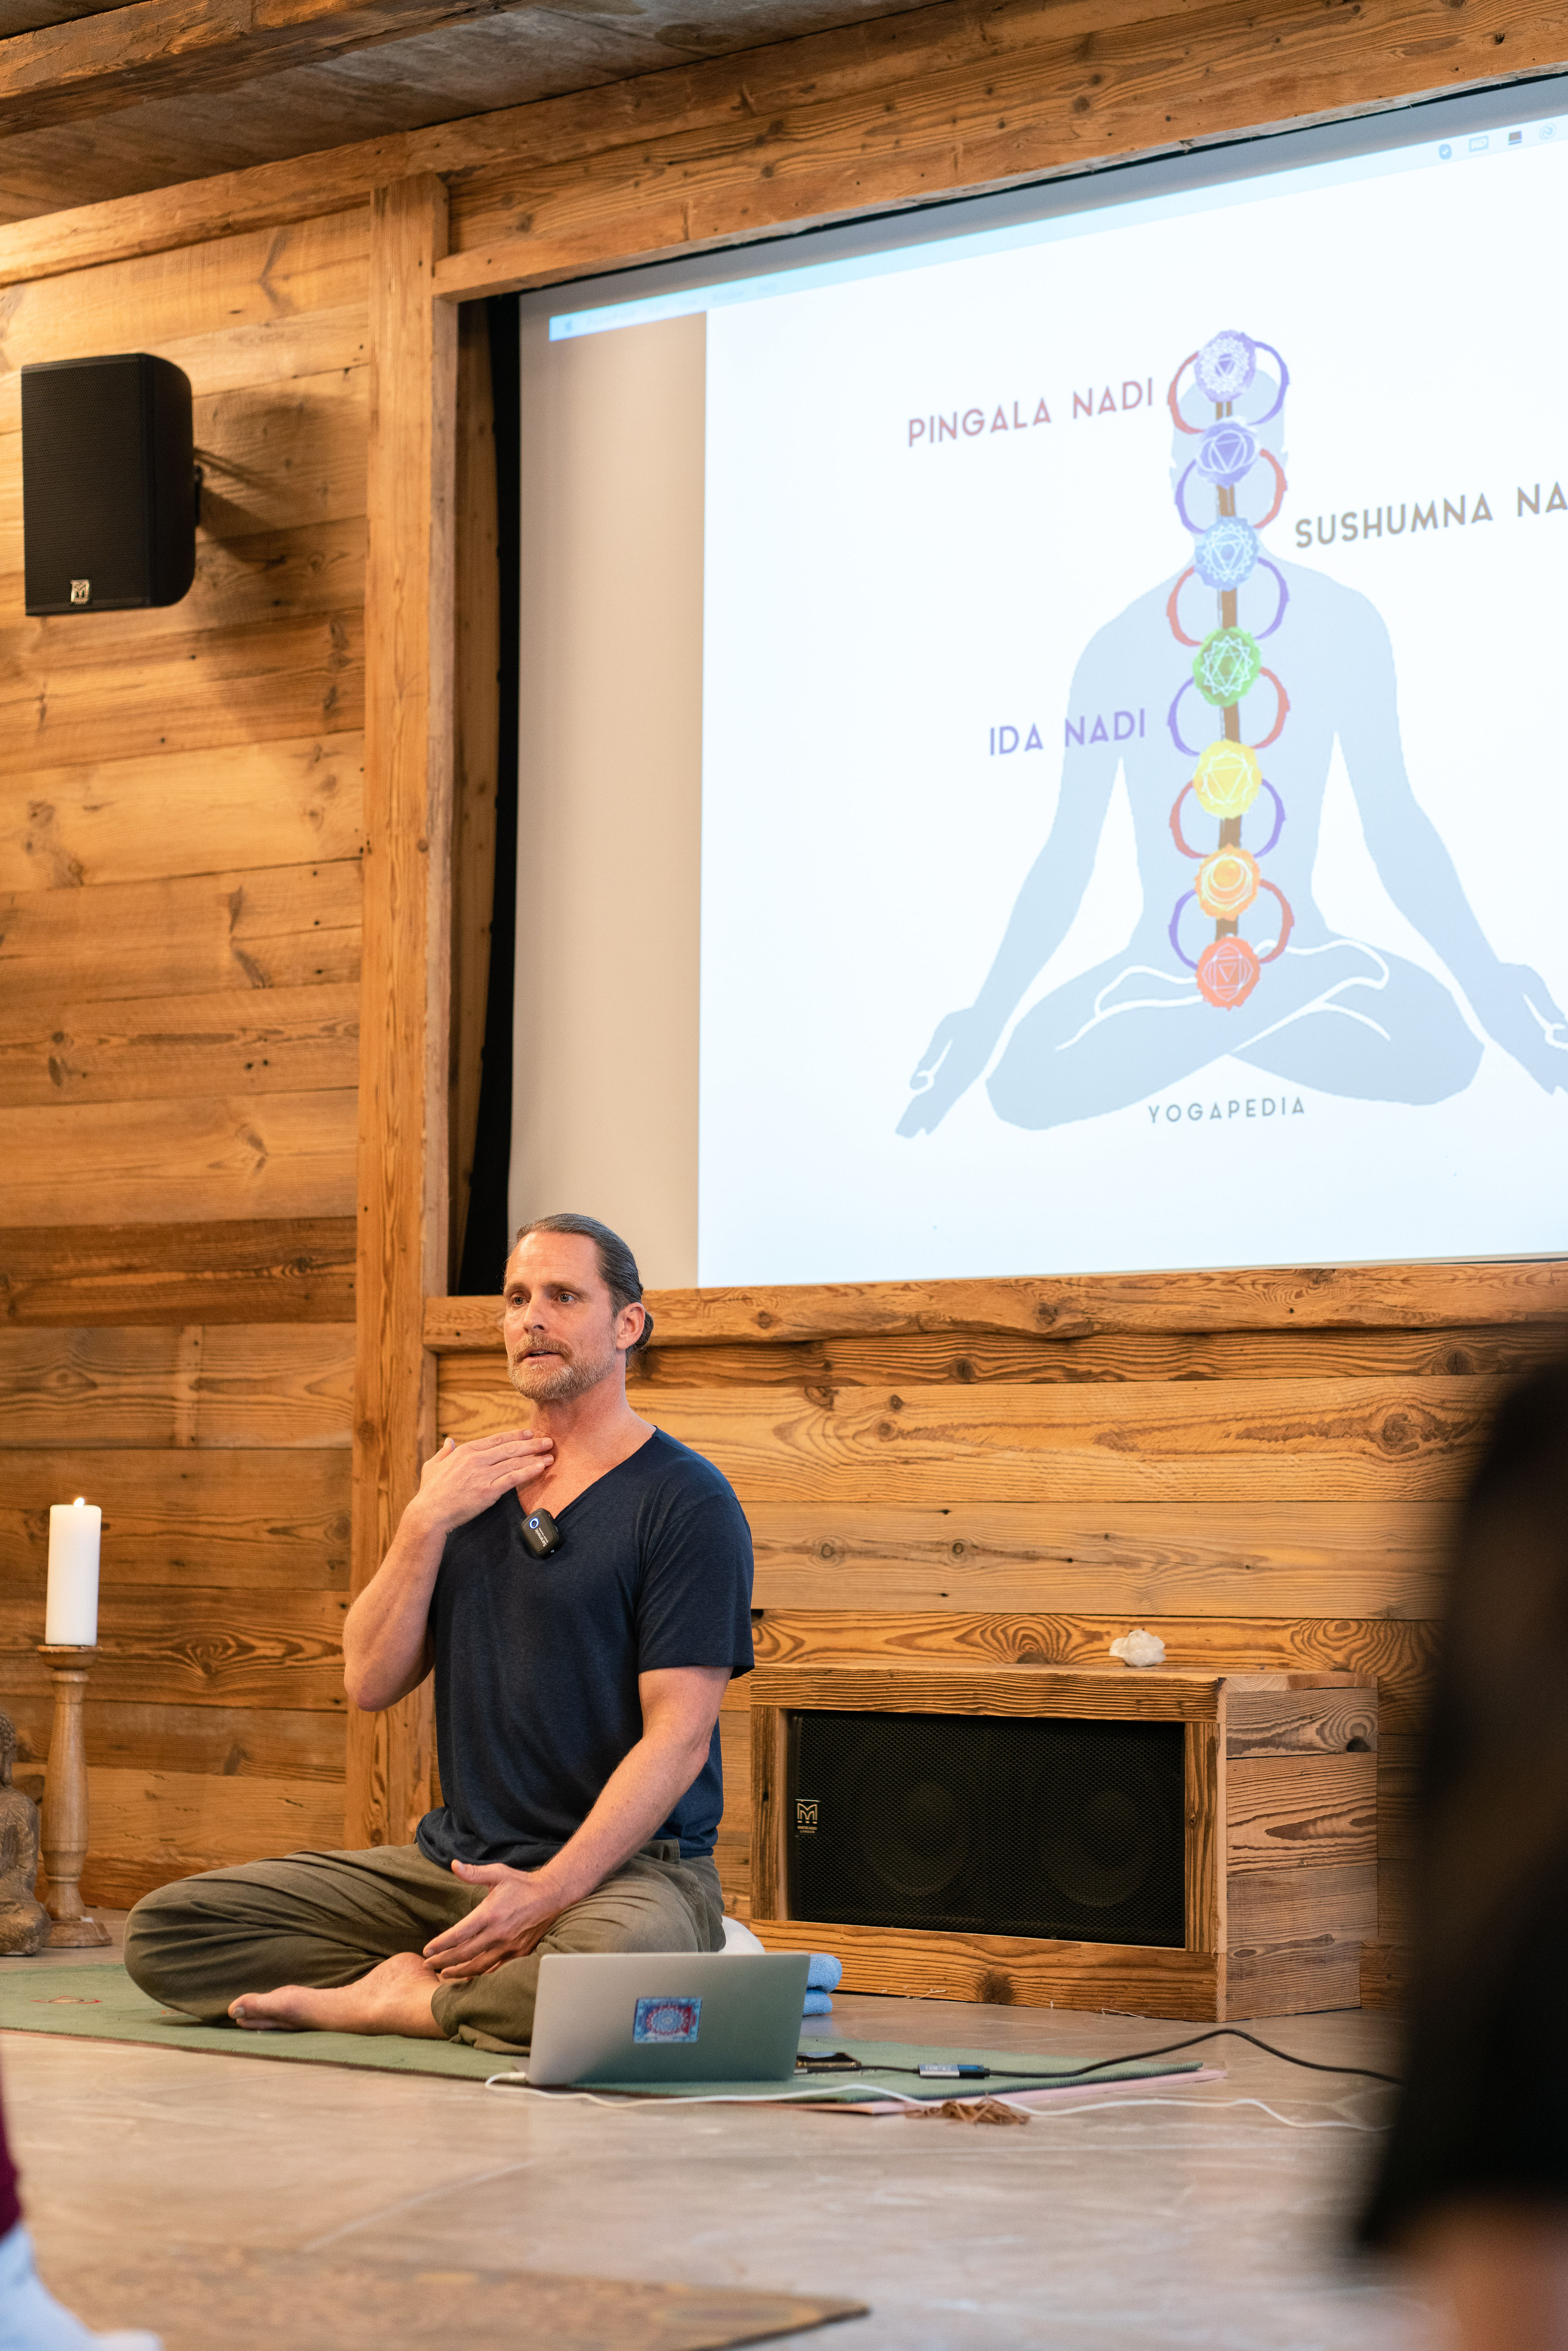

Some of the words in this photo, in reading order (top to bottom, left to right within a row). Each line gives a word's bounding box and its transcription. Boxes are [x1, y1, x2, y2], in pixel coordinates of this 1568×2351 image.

[908, 397, 1052, 447] PINGALA
[1073, 377, 1152, 419] NADI
[1295, 492, 1493, 548] SUSHUMNA
[990, 722, 1044, 756] IDA
[1065, 708, 1145, 747] NADI
[1149, 1097, 1305, 1124] YOGAPEDIA
[535, 1528, 547, 1547] Saramonic
